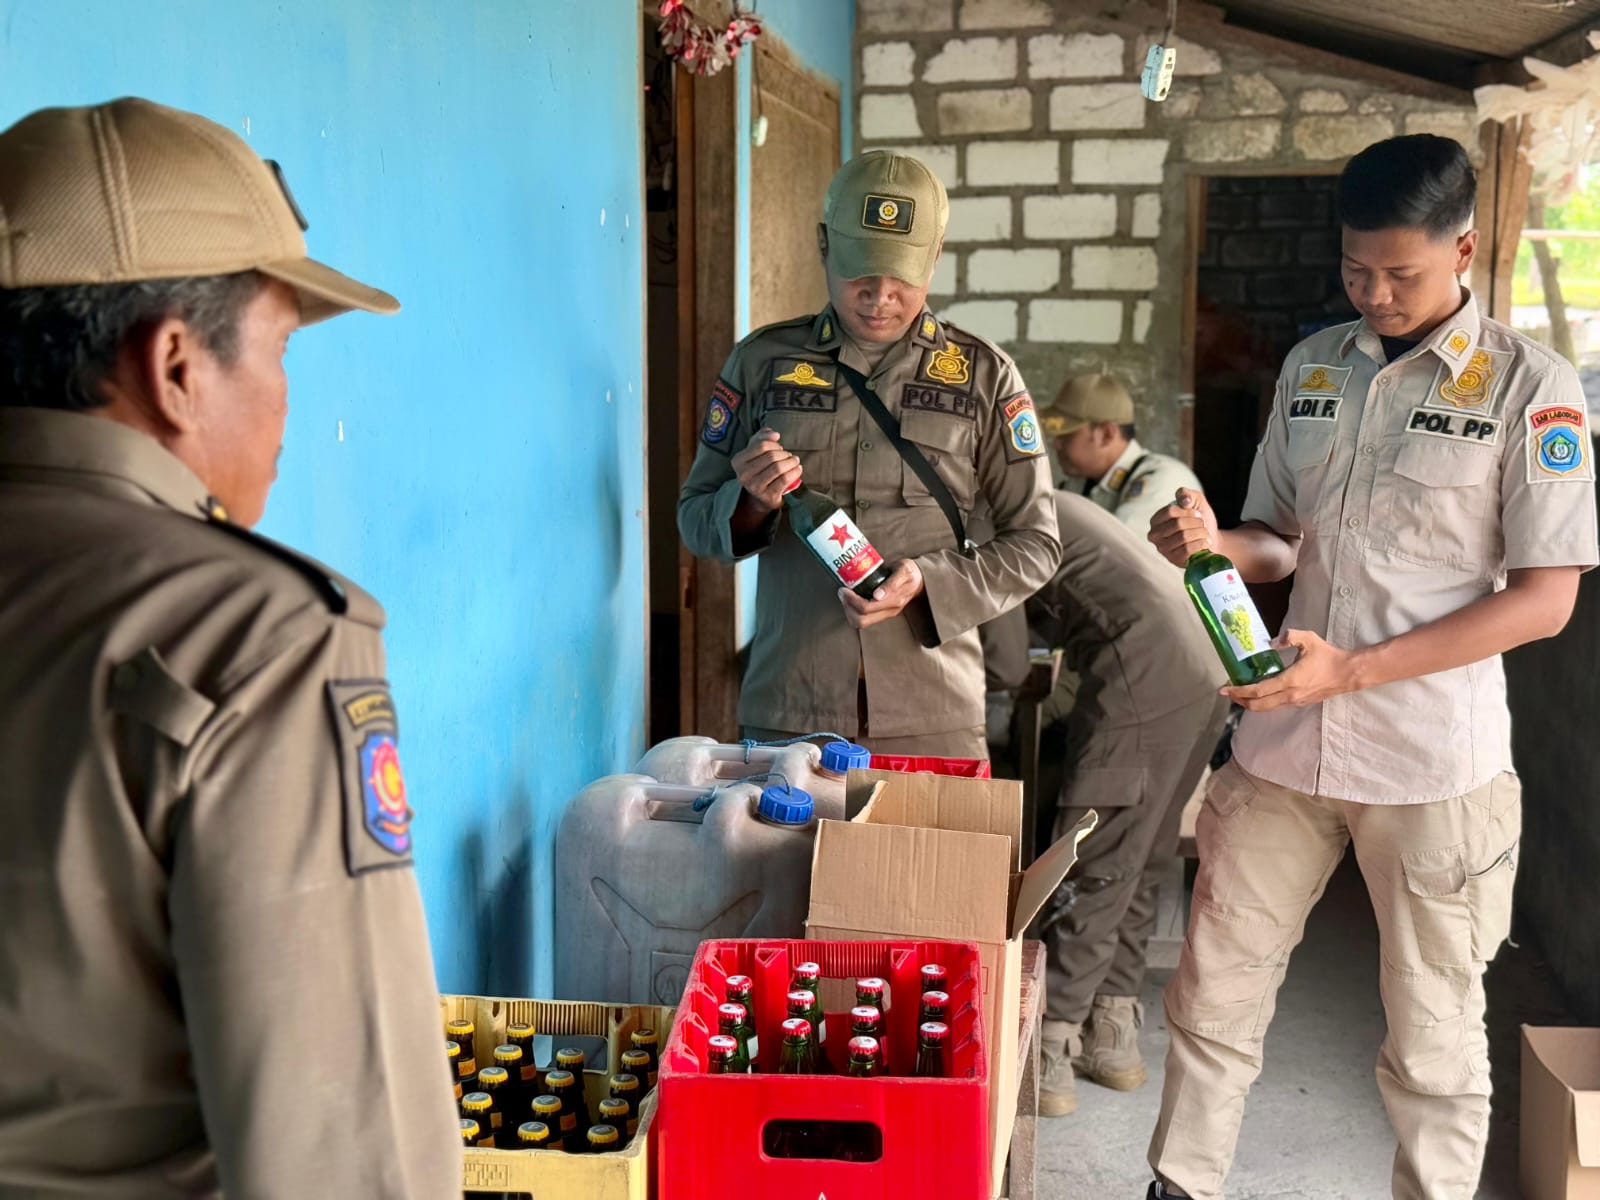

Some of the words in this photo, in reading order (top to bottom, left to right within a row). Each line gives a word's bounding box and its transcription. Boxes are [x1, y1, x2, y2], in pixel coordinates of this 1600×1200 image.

[773, 389, 825, 408] EKA
[907, 388, 946, 409] POL
[953, 395, 975, 416] PP
[1410, 411, 1454, 435] POL
[1462, 419, 1494, 440] PP
[832, 536, 868, 569] BINTAN
